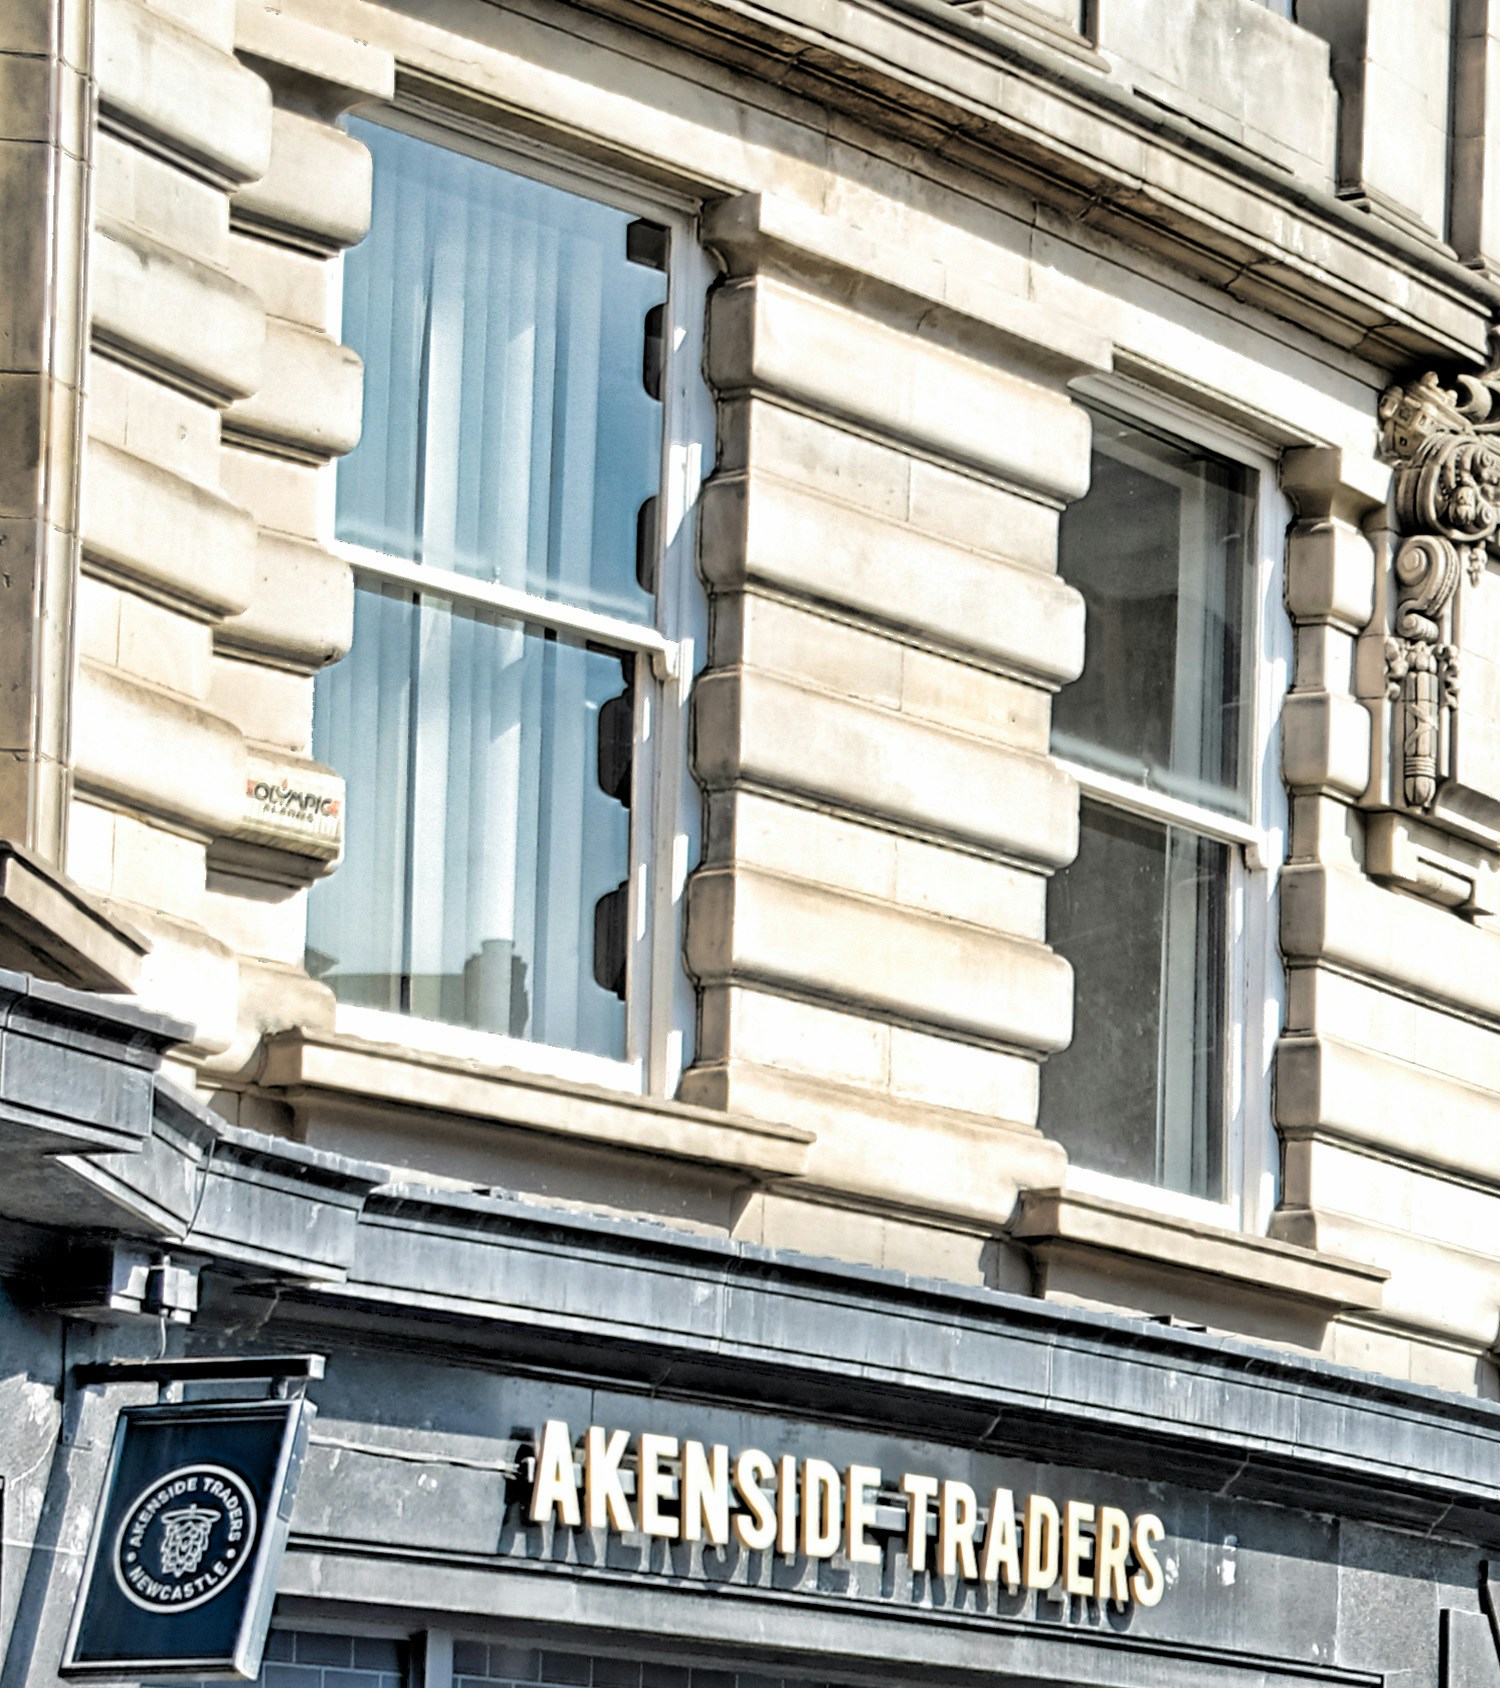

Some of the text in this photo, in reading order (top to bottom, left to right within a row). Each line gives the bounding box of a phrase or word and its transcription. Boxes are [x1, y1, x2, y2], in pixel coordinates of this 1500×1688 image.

[254, 782, 333, 817] OLYMPIC
[129, 1477, 244, 1548] AKENSIDE TRADERS
[531, 1419, 1167, 1608] AKENSIDE TRADERS
[129, 1560, 229, 1601] NEWCASTLE
